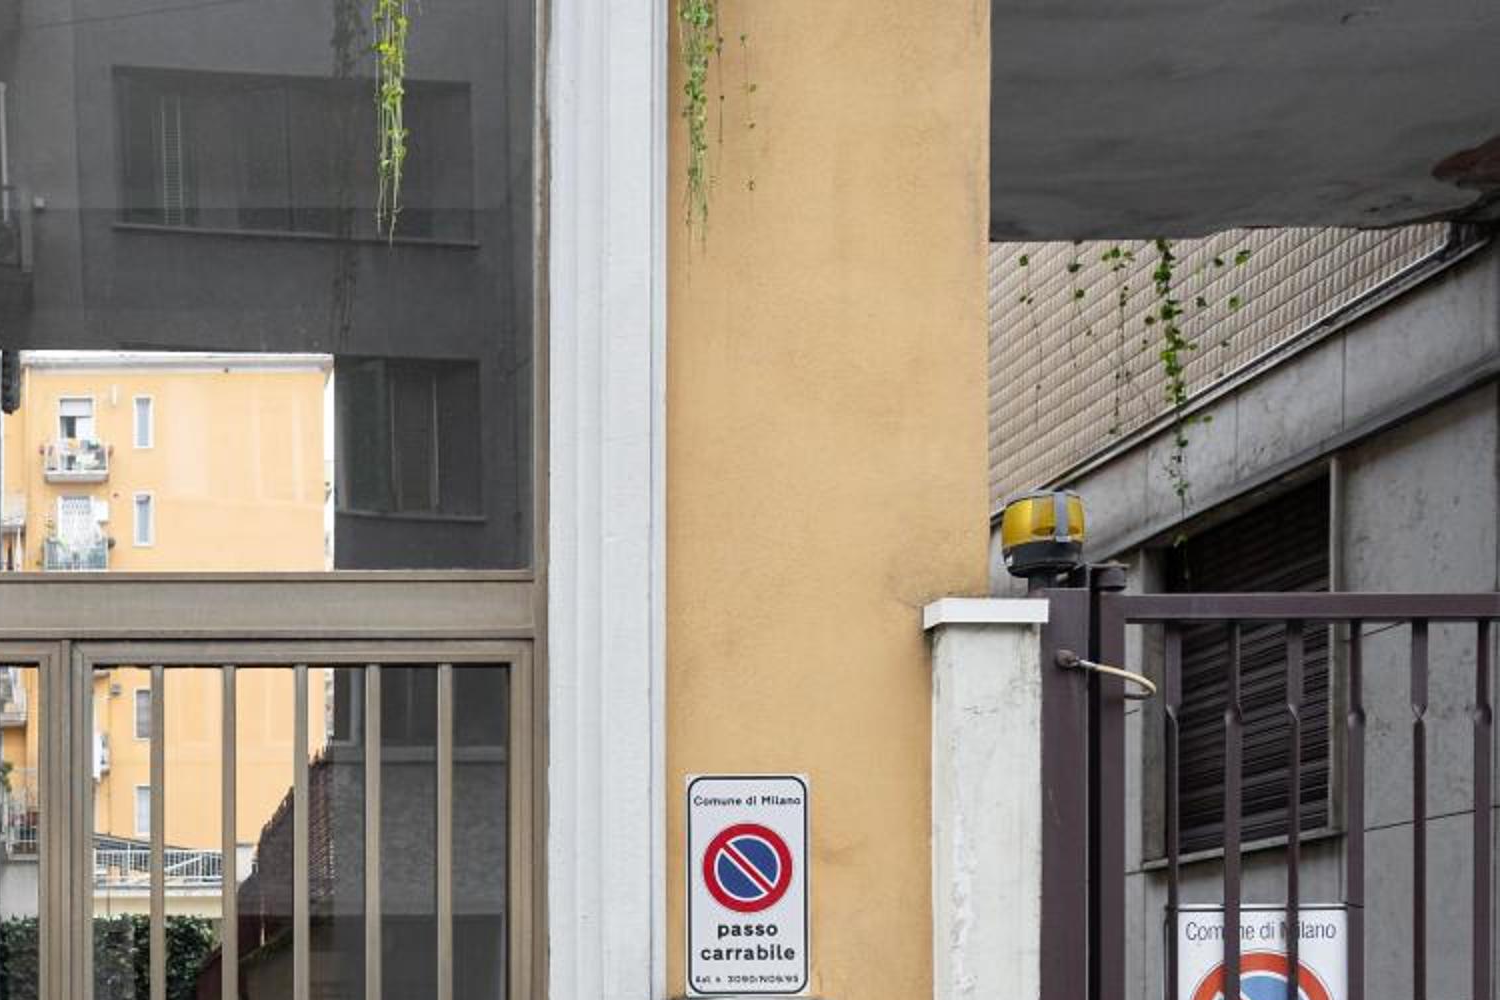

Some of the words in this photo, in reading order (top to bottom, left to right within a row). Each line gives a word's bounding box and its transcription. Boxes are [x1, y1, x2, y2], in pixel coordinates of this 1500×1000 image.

[693, 795, 742, 806] Comune
[746, 795, 757, 805] di
[761, 795, 801, 805] Milano
[717, 924, 778, 940] passo
[1186, 921, 1255, 940] Comne
[1259, 921, 1275, 940] di
[701, 944, 795, 960] carrabile
